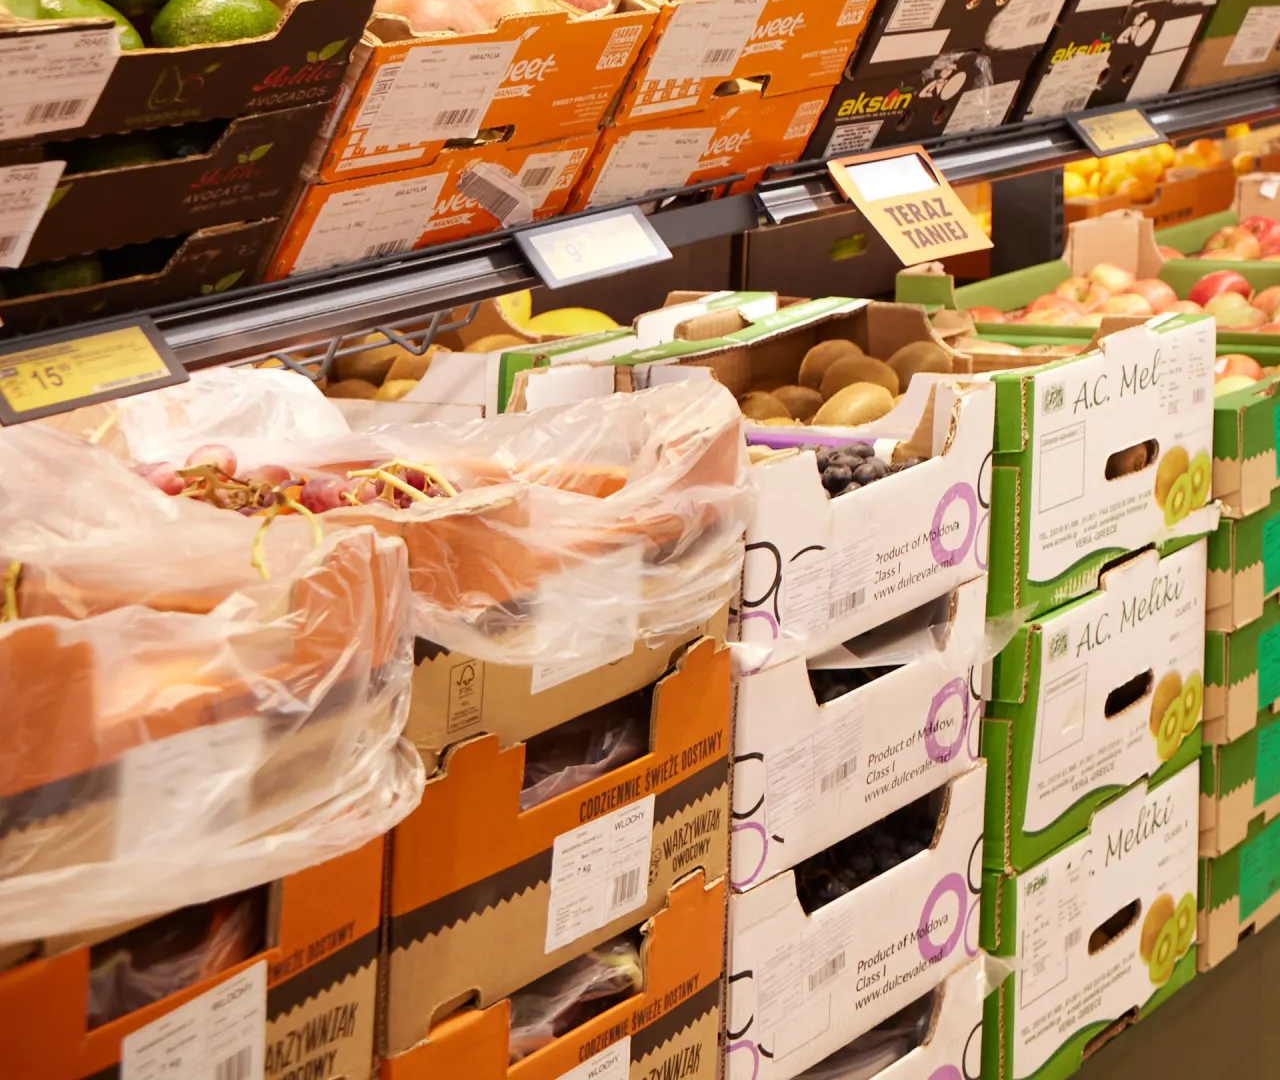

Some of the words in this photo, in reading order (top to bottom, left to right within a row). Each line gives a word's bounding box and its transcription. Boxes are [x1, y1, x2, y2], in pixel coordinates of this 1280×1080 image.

[749, 12, 804, 40] weet
[837, 10, 863, 26] 2023
[501, 53, 556, 84] eet
[597, 53, 628, 70] 2023
[245, 85, 329, 108] AVOCADOS
[837, 90, 912, 117] aksun
[181, 182, 250, 205] AVOCATS
[432, 215, 464, 228] MANGO
[883, 196, 953, 227] TERAZ
[901, 219, 969, 249] TANIEJ
[30, 365, 65, 391] 15
[1073, 374, 1110, 415] A.C.
[1119, 348, 1162, 398] Mel
[911, 534, 923, 551] of
[922, 519, 961, 544] Moldova
[1076, 612, 1111, 658] A.C.
[1119, 566, 1185, 634] Meliki
[680, 727, 724, 770] DOSTAWY
[867, 739, 905, 768] Product
[905, 731, 917, 748] of
[917, 717, 954, 741] Moldov
[865, 764, 890, 786] Class
[613, 810, 646, 832] WLOCHY
[662, 806, 723, 862] WARZYWNIAK
[1104, 793, 1174, 868] Meliki
[671, 836, 713, 873] OWOCOWY
[306, 919, 357, 962] DOSTAWY
[856, 943, 896, 975] Product
[896, 932, 908, 952] of
[909, 913, 950, 944] Moldova
[663, 973, 700, 1011] DOSTAWY
[853, 947, 945, 1012] www.dulcevale.md
[855, 971, 881, 993] Class
[264, 1001, 360, 1074] ARZYWNIAK
[643, 1042, 703, 1080] ZYWNIAK
